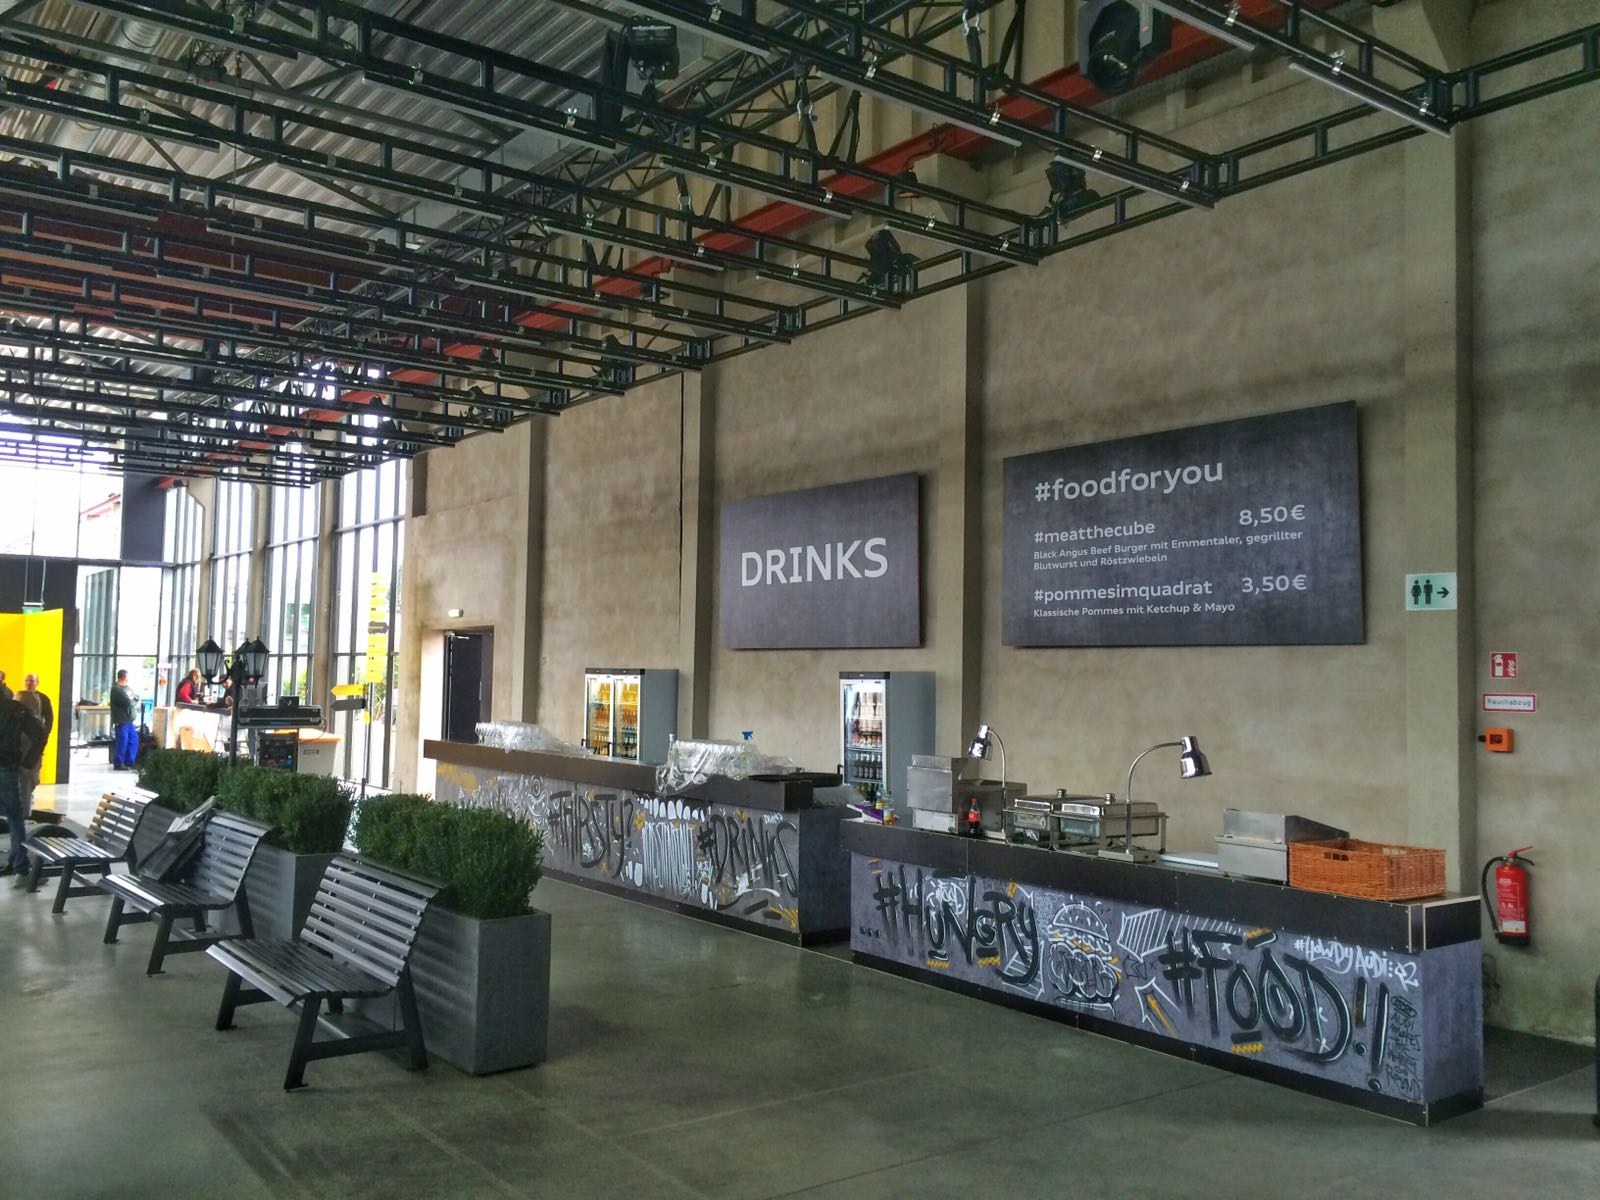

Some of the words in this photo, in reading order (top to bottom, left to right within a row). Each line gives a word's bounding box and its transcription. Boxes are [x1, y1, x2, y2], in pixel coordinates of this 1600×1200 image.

[1034, 462, 1223, 501] #foodforyou
[1034, 521, 1156, 543] #meatthecube
[1033, 550, 1057, 560] Black
[1059, 547, 1088, 559] Angus
[1090, 545, 1113, 555] Beef
[1114, 543, 1148, 554] Burger
[1150, 541, 1169, 550] mit
[1171, 535, 1243, 549] Emmentaler,
[1246, 530, 1303, 545] gegrillter
[741, 537, 888, 587] DRINKS
[1033, 560, 1078, 571] Blutwurst
[1080, 558, 1098, 568] und
[1100, 553, 1168, 566] Röstzwiebeln
[1034, 580, 1213, 604] #pommesimquadrat
[1033, 608, 1080, 618] Klassische
[1081, 606, 1124, 617] Pommes
[1126, 605, 1144, 615] mit
[1146, 604, 1190, 616] Ketchup
[1192, 604, 1202, 613] &
[1204, 602, 1236, 615] Mayo
